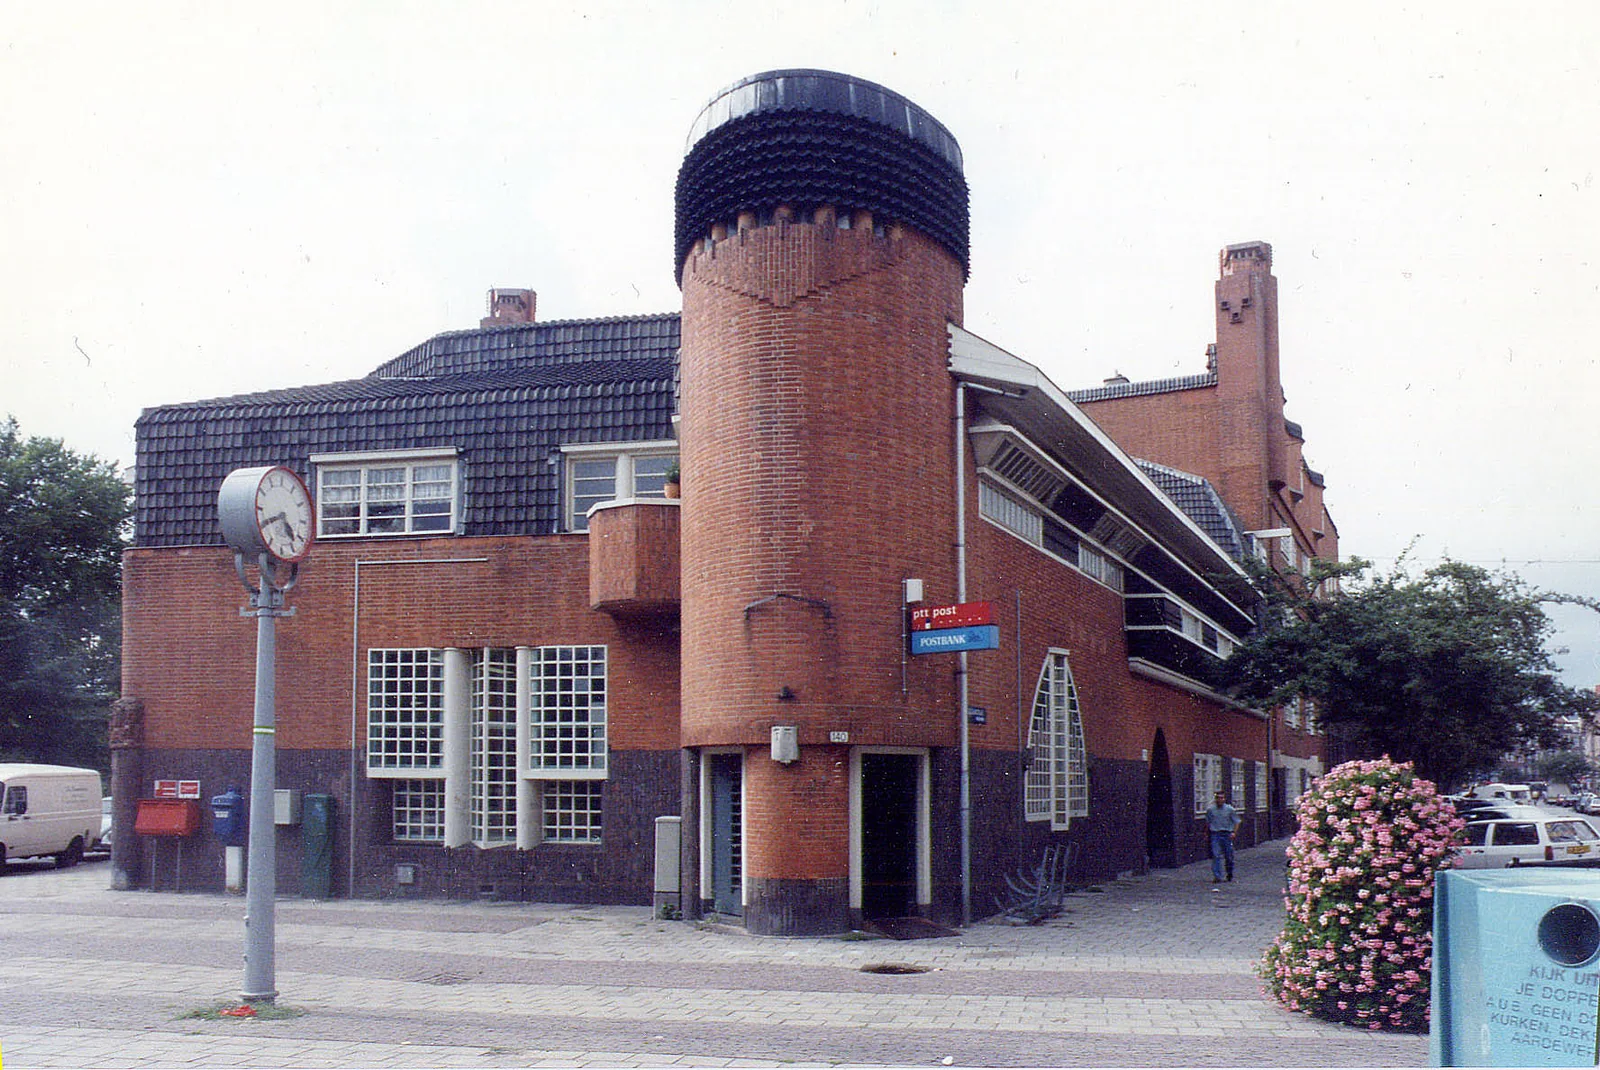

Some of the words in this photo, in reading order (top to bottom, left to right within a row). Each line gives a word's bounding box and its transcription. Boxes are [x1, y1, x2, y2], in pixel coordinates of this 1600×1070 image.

[913, 609, 930, 621] ptt
[933, 605, 957, 619] post
[920, 634, 967, 648] POSTBANK
[1529, 965, 1567, 982] KIJK
[1515, 982, 1535, 997] JE
[1531, 1003, 1572, 1022] GEEN
